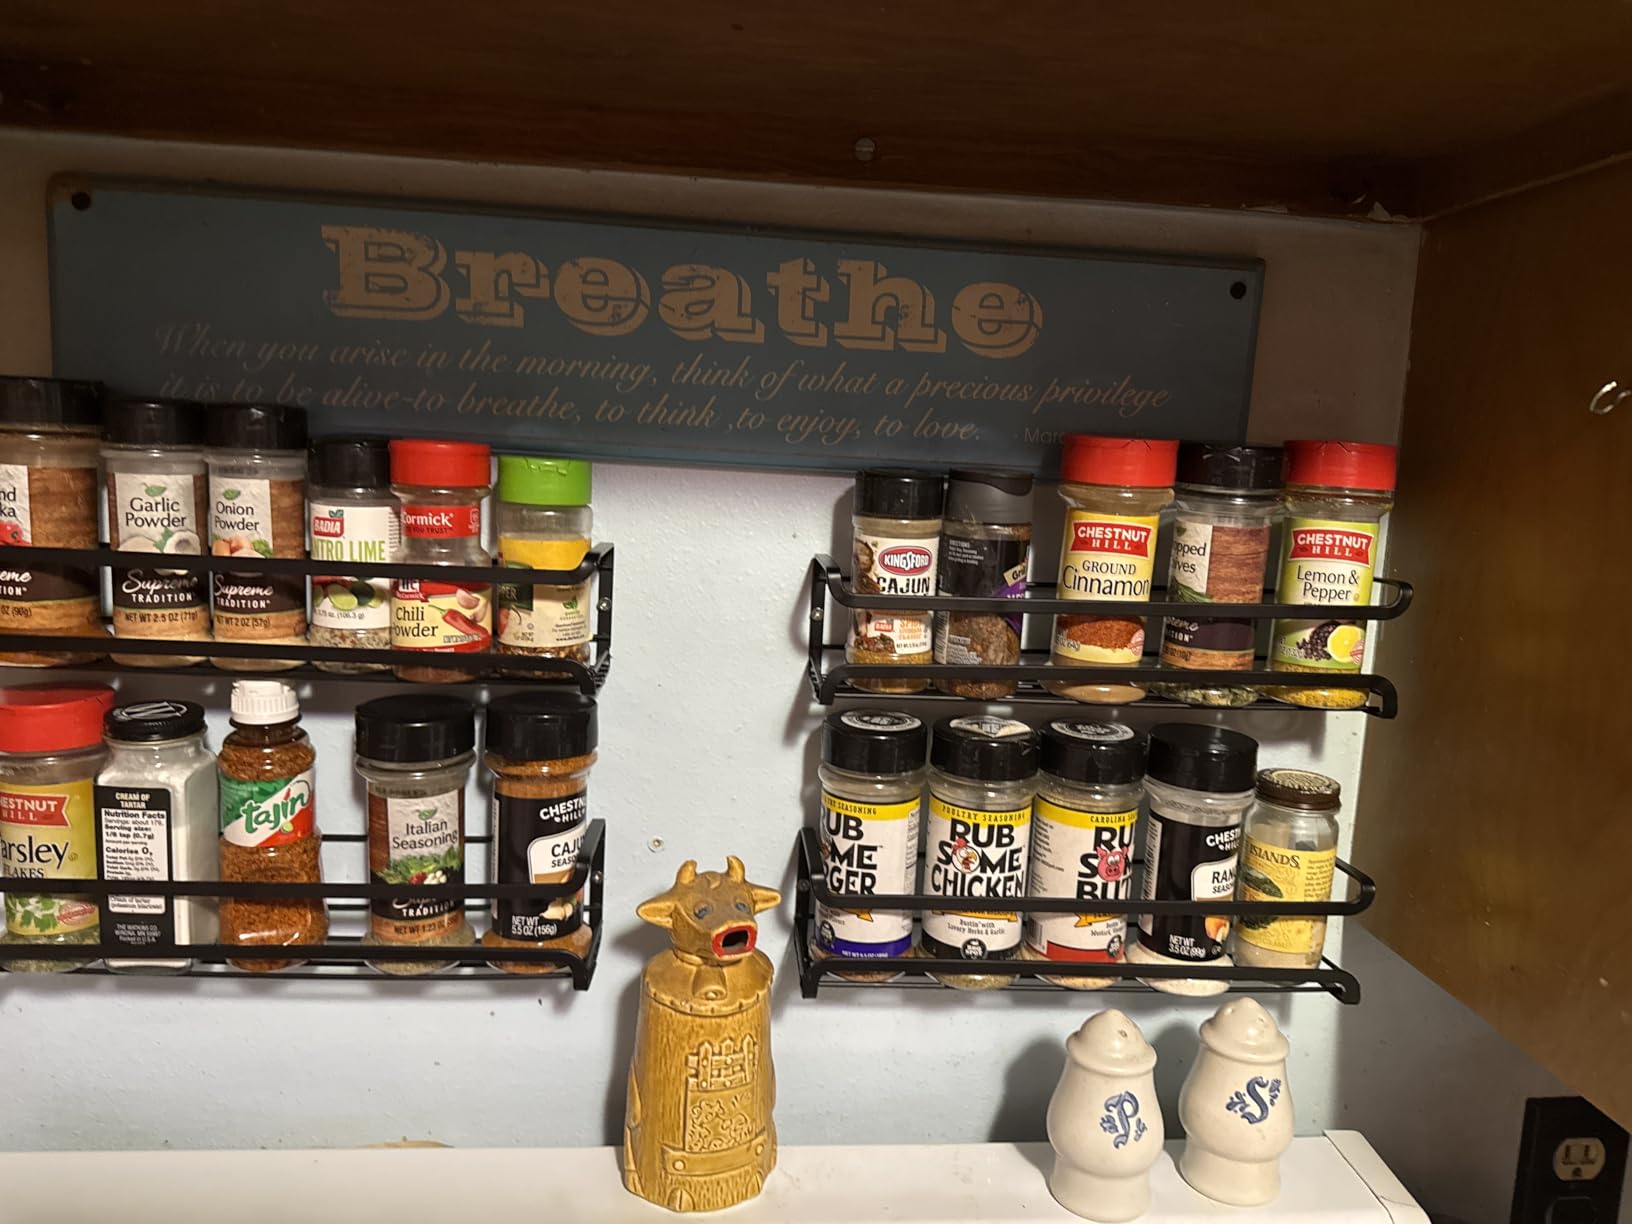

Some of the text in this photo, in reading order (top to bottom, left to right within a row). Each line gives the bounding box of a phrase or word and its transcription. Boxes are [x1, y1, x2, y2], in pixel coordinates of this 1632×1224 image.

[320, 225, 1043, 358] Breathe
[155, 321, 1170, 418] When you arise in the morning, think of what a precious privilege
[160, 373, 186, 400] it
[195, 374, 220, 402] is
[232, 378, 265, 402] to
[276, 372, 312, 405] be
[456, 382, 582, 424] breathe,
[595, 399, 628, 423] to
[636, 393, 716, 429] think
[777, 409, 861, 446] enjoy,
[873, 415, 904, 437] to
[913, 408, 982, 442] love.
[1024, 427, 1066, 445] Marc
[129, 497, 180, 512] Garlic
[215, 501, 255, 516] Onion
[125, 512, 187, 528] Powder
[214, 516, 260, 531] Powder
[313, 517, 342, 535] BADIA
[1077, 526, 1148, 544] CHESTNUT
[1297, 533, 1369, 553] CHESTNUT
[349, 540, 386, 562] LIME
[1091, 539, 1132, 551] HILL
[1311, 545, 1353, 557] HILL
[883, 551, 929, 570] KINGSFORD
[1082, 560, 1136, 576] GROUND
[1062, 565, 1150, 596] Cinnamon
[1297, 564, 1360, 585] Lemon &
[213, 574, 273, 602] Supreme
[876, 576, 930, 594] CAJUN
[1303, 581, 1352, 602] Pepper
[130, 593, 192, 603] TRADITION
[217, 597, 268, 609] TRADITION
[395, 606, 425, 622] Chili
[0, 797, 58, 812] ESTNUT
[115, 792, 151, 802] CREAM OF
[120, 801, 147, 810] TARTAR
[837, 802, 877, 816] SEASONING
[942, 804, 978, 819] POULTRY
[104, 810, 165, 819] Nutrition Facts
[1090, 815, 1126, 824] CAROLINA
[105, 824, 132, 833] Serving
[405, 820, 448, 836] Italian
[950, 817, 1015, 849] RUB
[392, 830, 459, 850] Seasoning
[551, 835, 585, 858] CAJU
[0, 835, 69, 870] arsley
[105, 846, 139, 855] Calories
[931, 863, 1025, 898] CHICKEN
[512, 915, 540, 926] NET WT
[1169, 934, 1195, 947] NET WT
[1240, 1075, 1270, 1125] S
[1104, 1090, 1140, 1150] P
